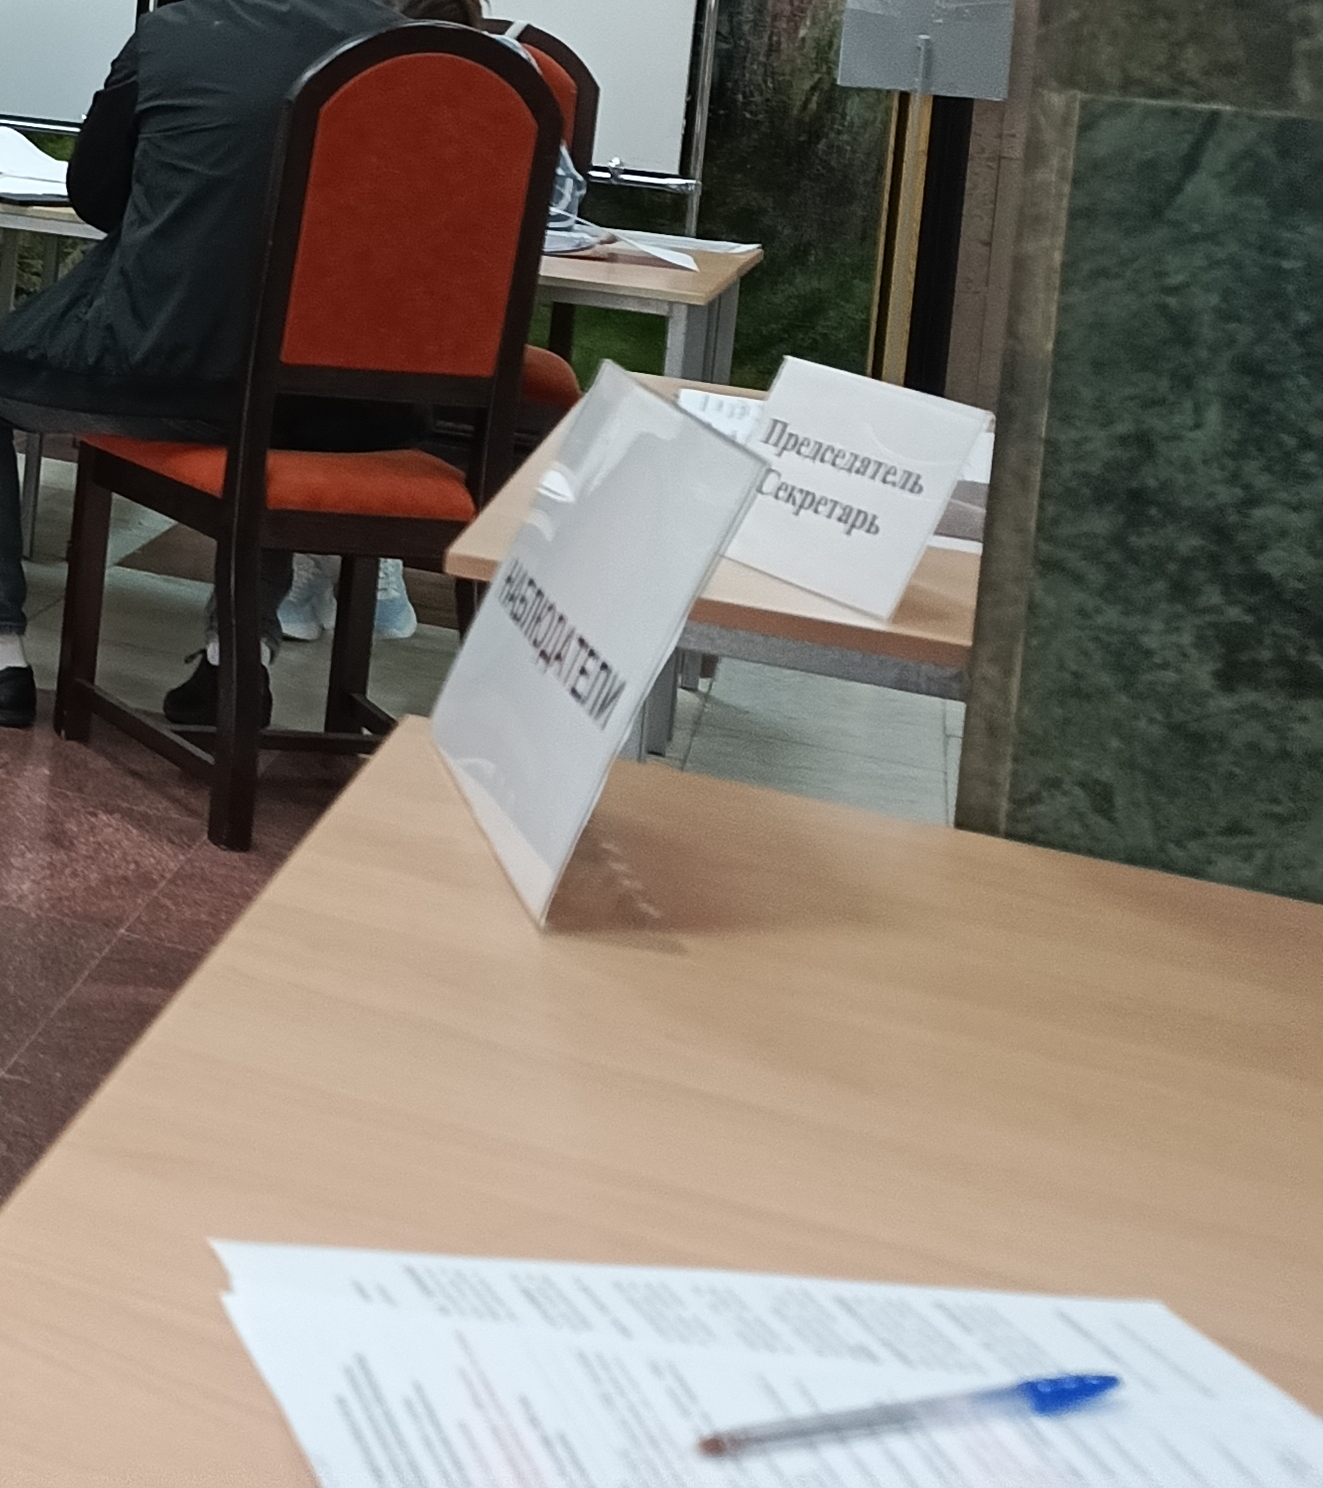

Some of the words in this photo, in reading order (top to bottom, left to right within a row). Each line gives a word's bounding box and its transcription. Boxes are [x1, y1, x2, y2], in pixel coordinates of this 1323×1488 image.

[761, 418, 925, 496] Председатель
[756, 468, 882, 536] Секретарь
[497, 560, 628, 732] НАБЛЮДАТЕЛИ
